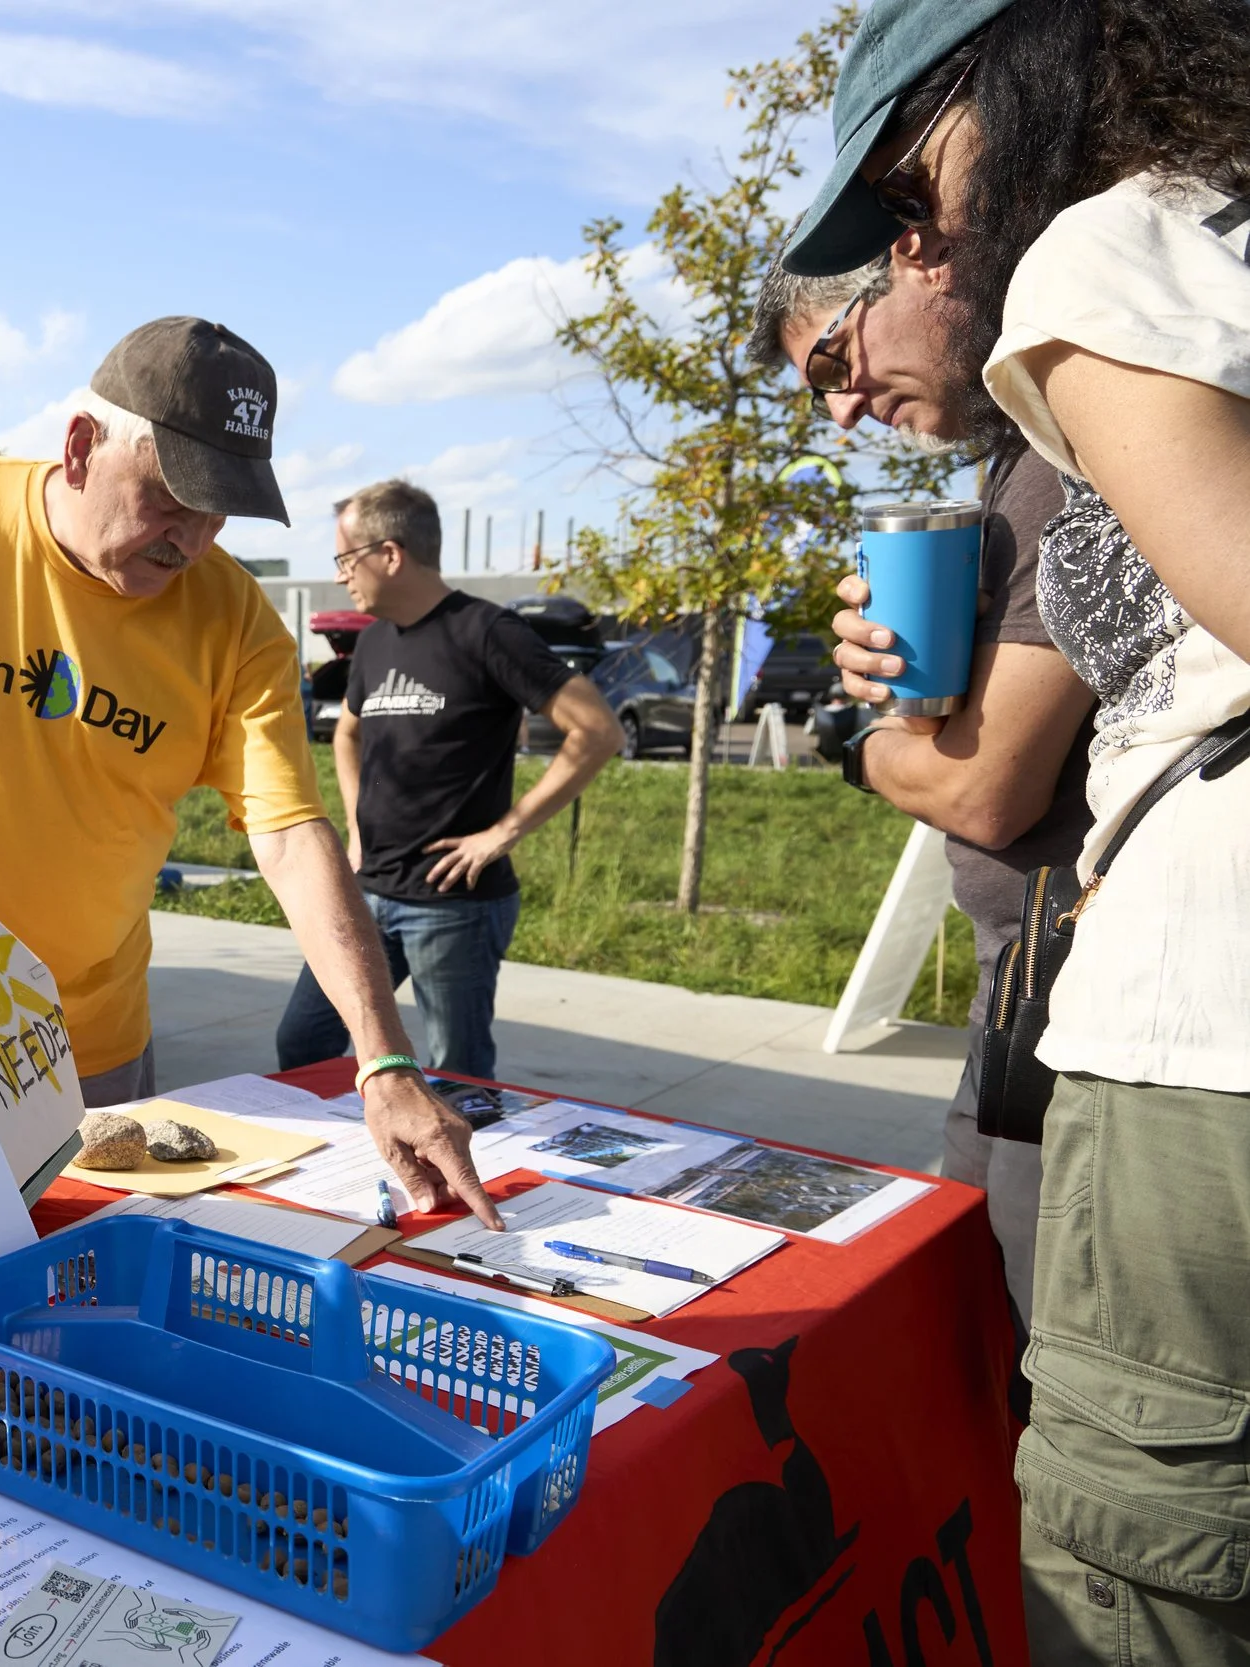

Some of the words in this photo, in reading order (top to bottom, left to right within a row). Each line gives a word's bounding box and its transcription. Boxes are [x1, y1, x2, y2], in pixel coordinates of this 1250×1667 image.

[227, 387, 268, 411] KAMALA
[233, 401, 263, 426] 47
[224, 420, 269, 440] HARRIS
[81, 684, 167, 754] Day
[1, 1533, 24, 1548] WITH
[21, 1521, 47, 1538] EACH
[0, 1557, 36, 1579] currently
[33, 1544, 58, 1560] doing
[54, 1537, 70, 1550] the
[75, 1551, 100, 1567] action
[6, 1596, 25, 1610] plan
[13, 1624, 44, 1647] Join
